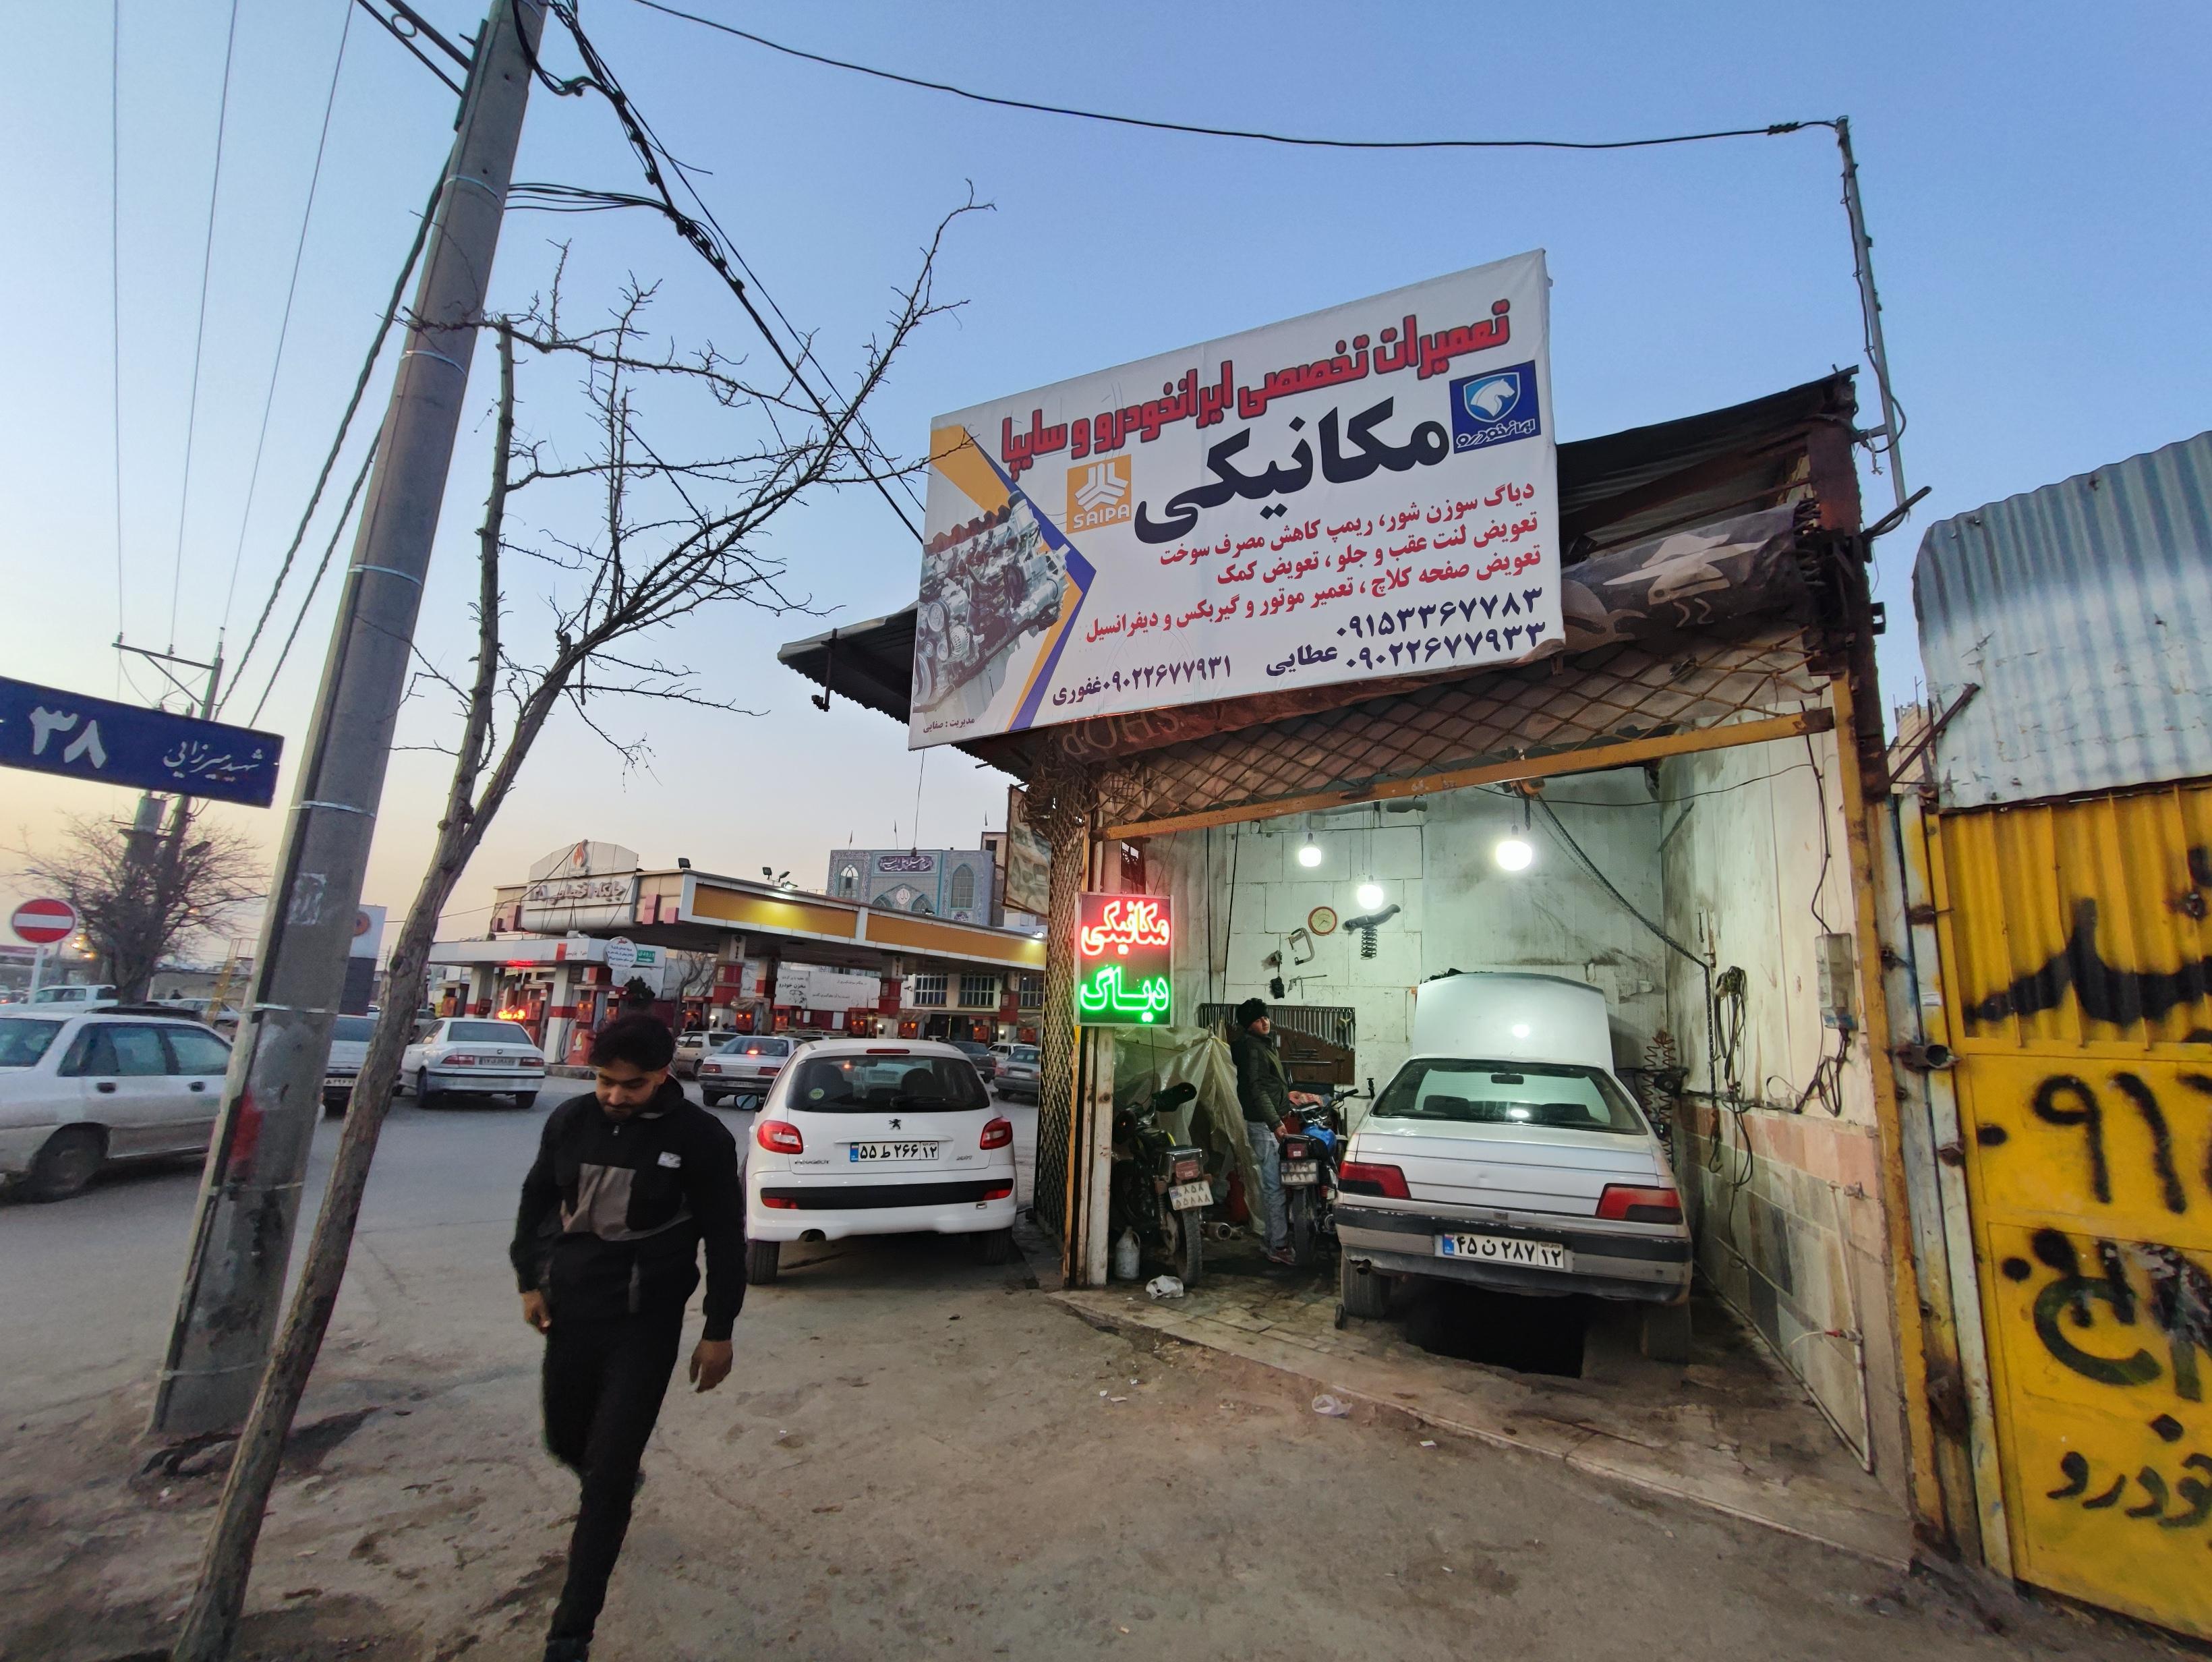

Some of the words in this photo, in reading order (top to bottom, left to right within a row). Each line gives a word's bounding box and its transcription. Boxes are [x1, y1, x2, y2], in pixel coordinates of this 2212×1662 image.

[1373, 299, 1510, 380] تعمیرات
[1238, 335, 1370, 420] تخصصی
[1001, 409, 1068, 482] سایپا
[1071, 418, 1090, 460] و
[1134, 396, 1449, 544] مکانیکی
[1484, 482, 1535, 507] دیاگ
[1074, 504, 1130, 529] SAIPA
[1426, 498, 1478, 523] سوزن
[1271, 519, 1320, 551] کاهش
[1327, 517, 1373, 542] ریمپ
[1433, 523, 1466, 549] لنت
[1474, 511, 1538, 548] تعویض
[1160, 543, 1209, 565] سوخت
[1215, 534, 1265, 558] مصرف
[1374, 548, 1383, 565] و
[1389, 535, 1427, 561] عقب
[1217, 560, 1257, 584] کمک
[1263, 550, 1319, 583] تعویض
[1418, 561, 1469, 583] صفحه
[1476, 544, 1541, 581] تعویض
[1259, 588, 1304, 616] موتور
[1310, 577, 1353, 608] تعمیر
[1163, 612, 1171, 631] و
[1177, 594, 1240, 627] گیربکس
[1245, 600, 1254, 618] و
[1337, 587, 1542, 638] ۰۹۱۵۳۳۶۷۷۸۳
[1086, 611, 1159, 642] دیفرانسیل
[1267, 643, 1338, 676] عطایی
[1346, 622, 1545, 668] ۰۹۰۲۲۶۷۷۹۳۳
[1103, 655, 1231, 692] ۰۹۰۲۲۶۷۷۹۳۱
[1053, 678, 1101, 706] غفوری
[29, 706, 107, 769] ۳۸
[950, 718, 975, 728] مدیریت
[1081, 900, 1170, 955] مکانیکی
[1080, 965, 1169, 1022] دیاگ
[1977, 1070, 2212, 1215] ۰۹۱
[1501, 1241, 1535, 1262] ۲۸۷
